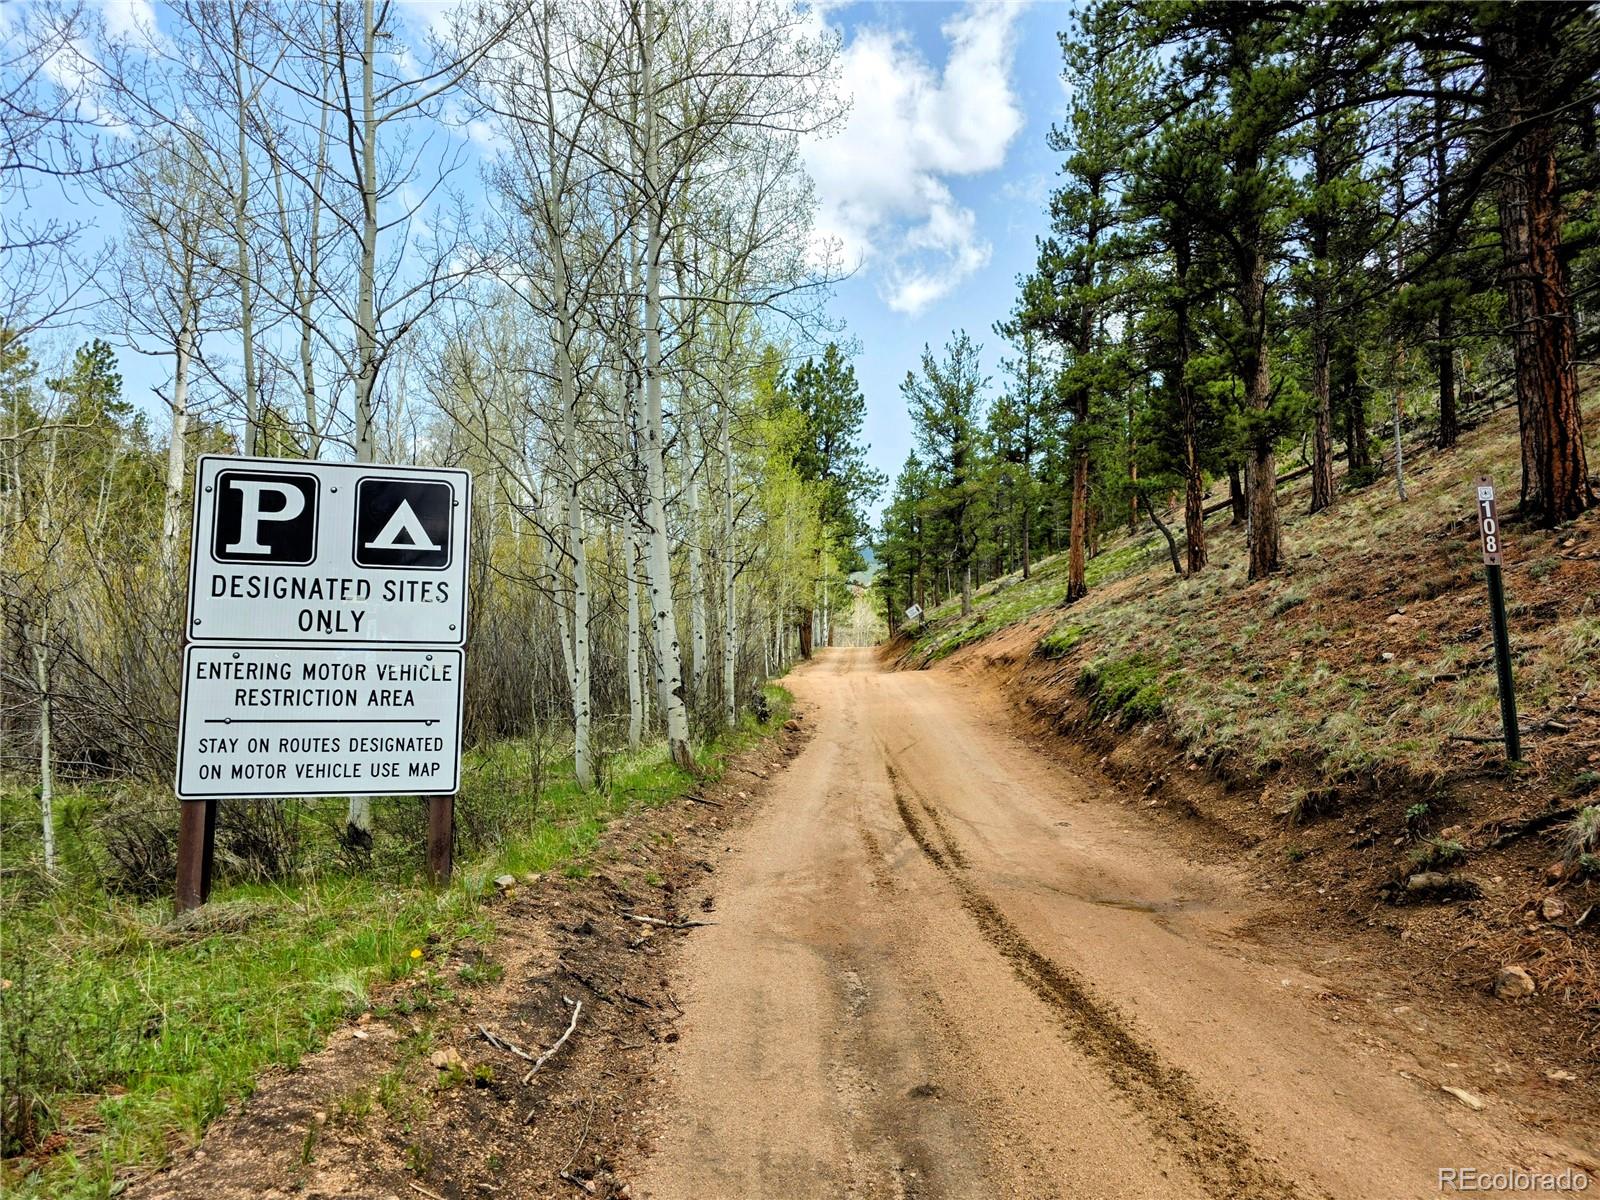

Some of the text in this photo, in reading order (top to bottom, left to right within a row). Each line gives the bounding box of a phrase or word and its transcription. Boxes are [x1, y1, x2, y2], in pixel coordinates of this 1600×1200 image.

[225, 480, 305, 555] P
[1481, 500, 1497, 552] 108
[212, 575, 449, 603] DESIGNATED SITES
[299, 610, 365, 633] ONLY
[197, 662, 452, 681] ENTERING MOTOR VEHICLE
[235, 689, 415, 707] RESTRICTION AREA
[199, 738, 443, 754] STAY ON ROUTES DESIGNATED
[199, 763, 440, 779] ON MOTOR VEHICLE USE MAP
